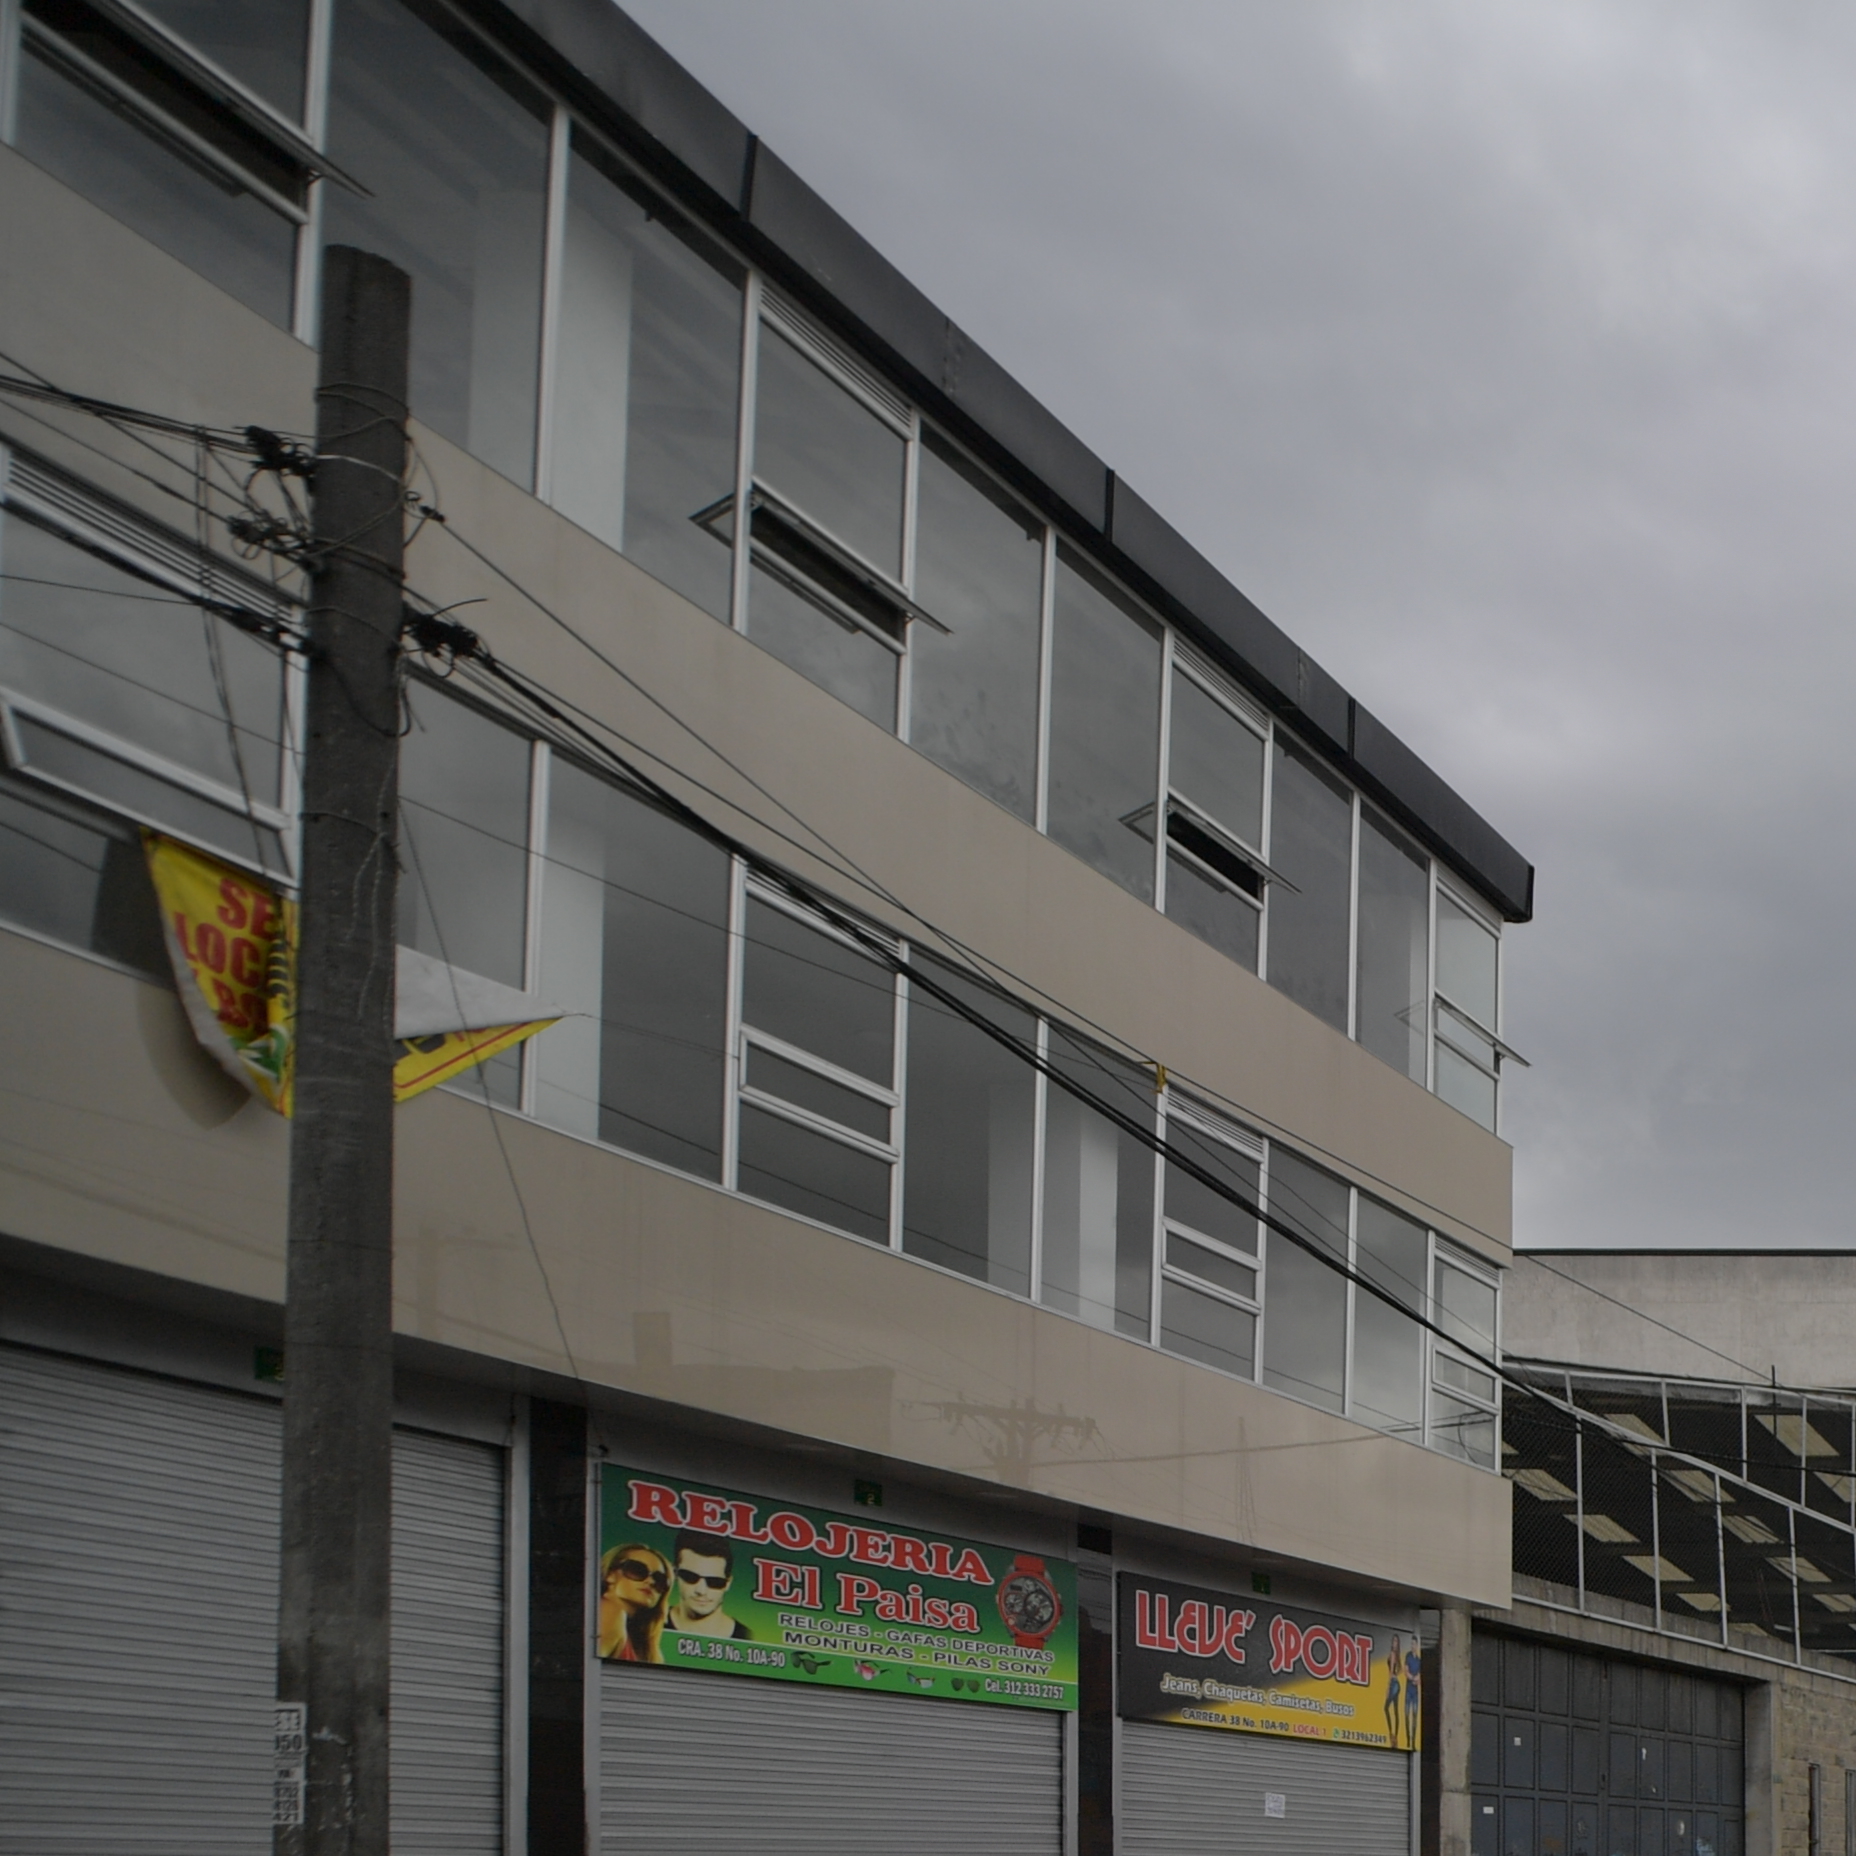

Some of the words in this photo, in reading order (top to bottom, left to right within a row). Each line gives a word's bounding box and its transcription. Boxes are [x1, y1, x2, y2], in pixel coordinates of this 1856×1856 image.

[175, 912, 266, 989] LOC
[628, 1480, 994, 1585] RELOJERIA
[753, 1558, 823, 1610] El
[836, 1573, 980, 1632] Paisa
[678, 1638, 704, 1656] CRA.
[708, 1643, 723, 1659] 38
[725, 1647, 743, 1661] No.
[747, 1648, 785, 1668] 10A-90
[779, 1614, 869, 1637] RELOJES
[887, 1631, 946, 1648] GAFAS
[952, 1639, 1054, 1662] DEPORTIVAS
[785, 1632, 914, 1659] MONTURAS
[934, 1652, 991, 1669] PILAS
[997, 1660, 1049, 1676] SONY
[1269, 1614, 1372, 1686] SPORT
[1004, 1681, 1021, 1696] 312
[1325, 1700, 1354, 1716] Busos
[1182, 1708, 1227, 1724] CARRERA
[1229, 1714, 1241, 1726] 38
[1260, 1720, 1289, 1732] 10A-90
[1293, 1724, 1319, 1736] LOCAL
